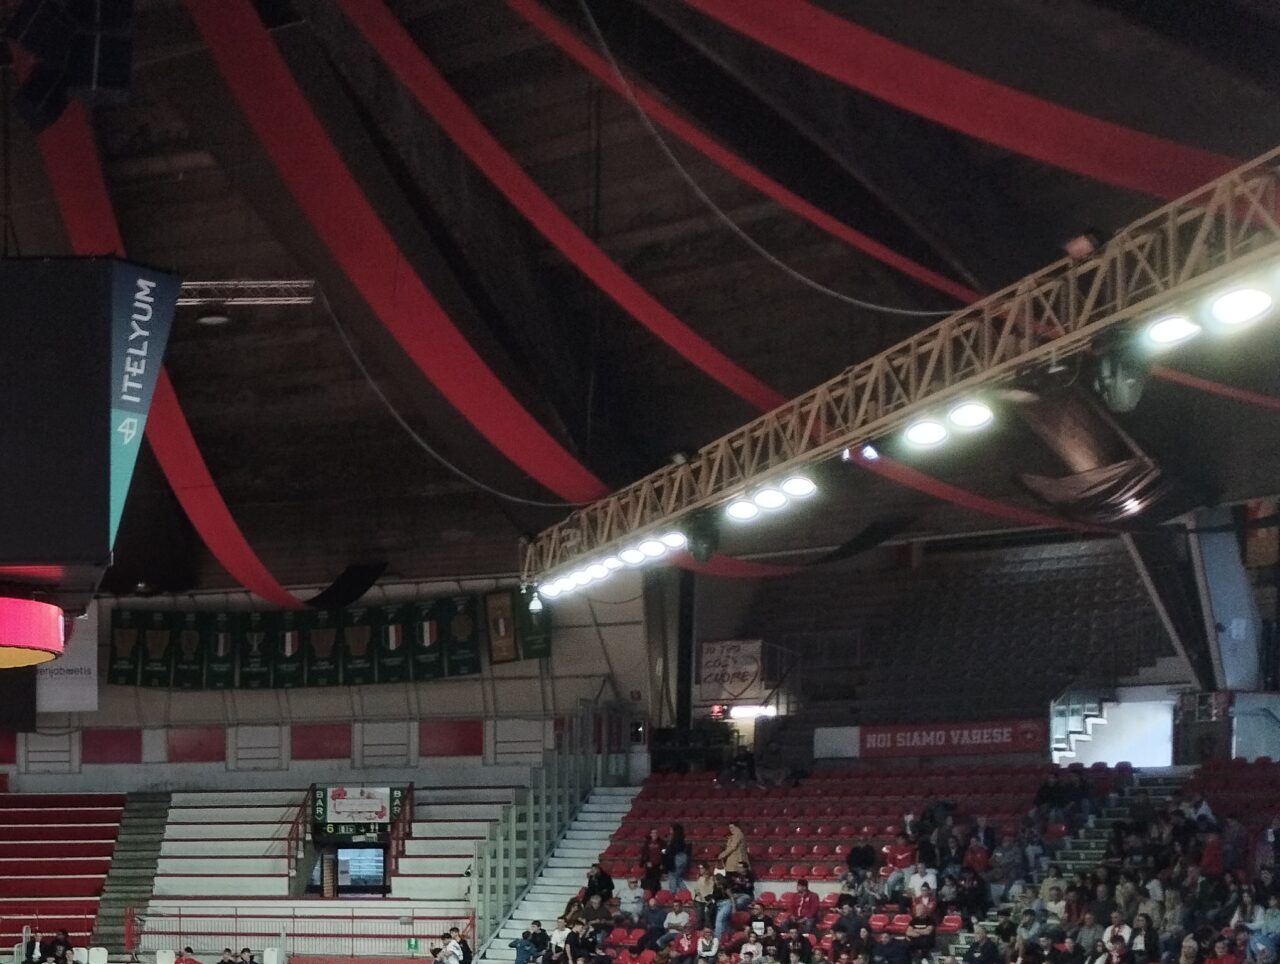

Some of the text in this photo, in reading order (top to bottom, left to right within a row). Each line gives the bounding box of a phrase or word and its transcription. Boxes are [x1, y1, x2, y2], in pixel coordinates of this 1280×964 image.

[121, 278, 156, 402] ITELYUM
[39, 666, 92, 678] enjobmetis
[866, 728, 1012, 749] NOI SIAMO VARESE
[316, 790, 324, 815] BAR
[326, 824, 334, 833] 6
